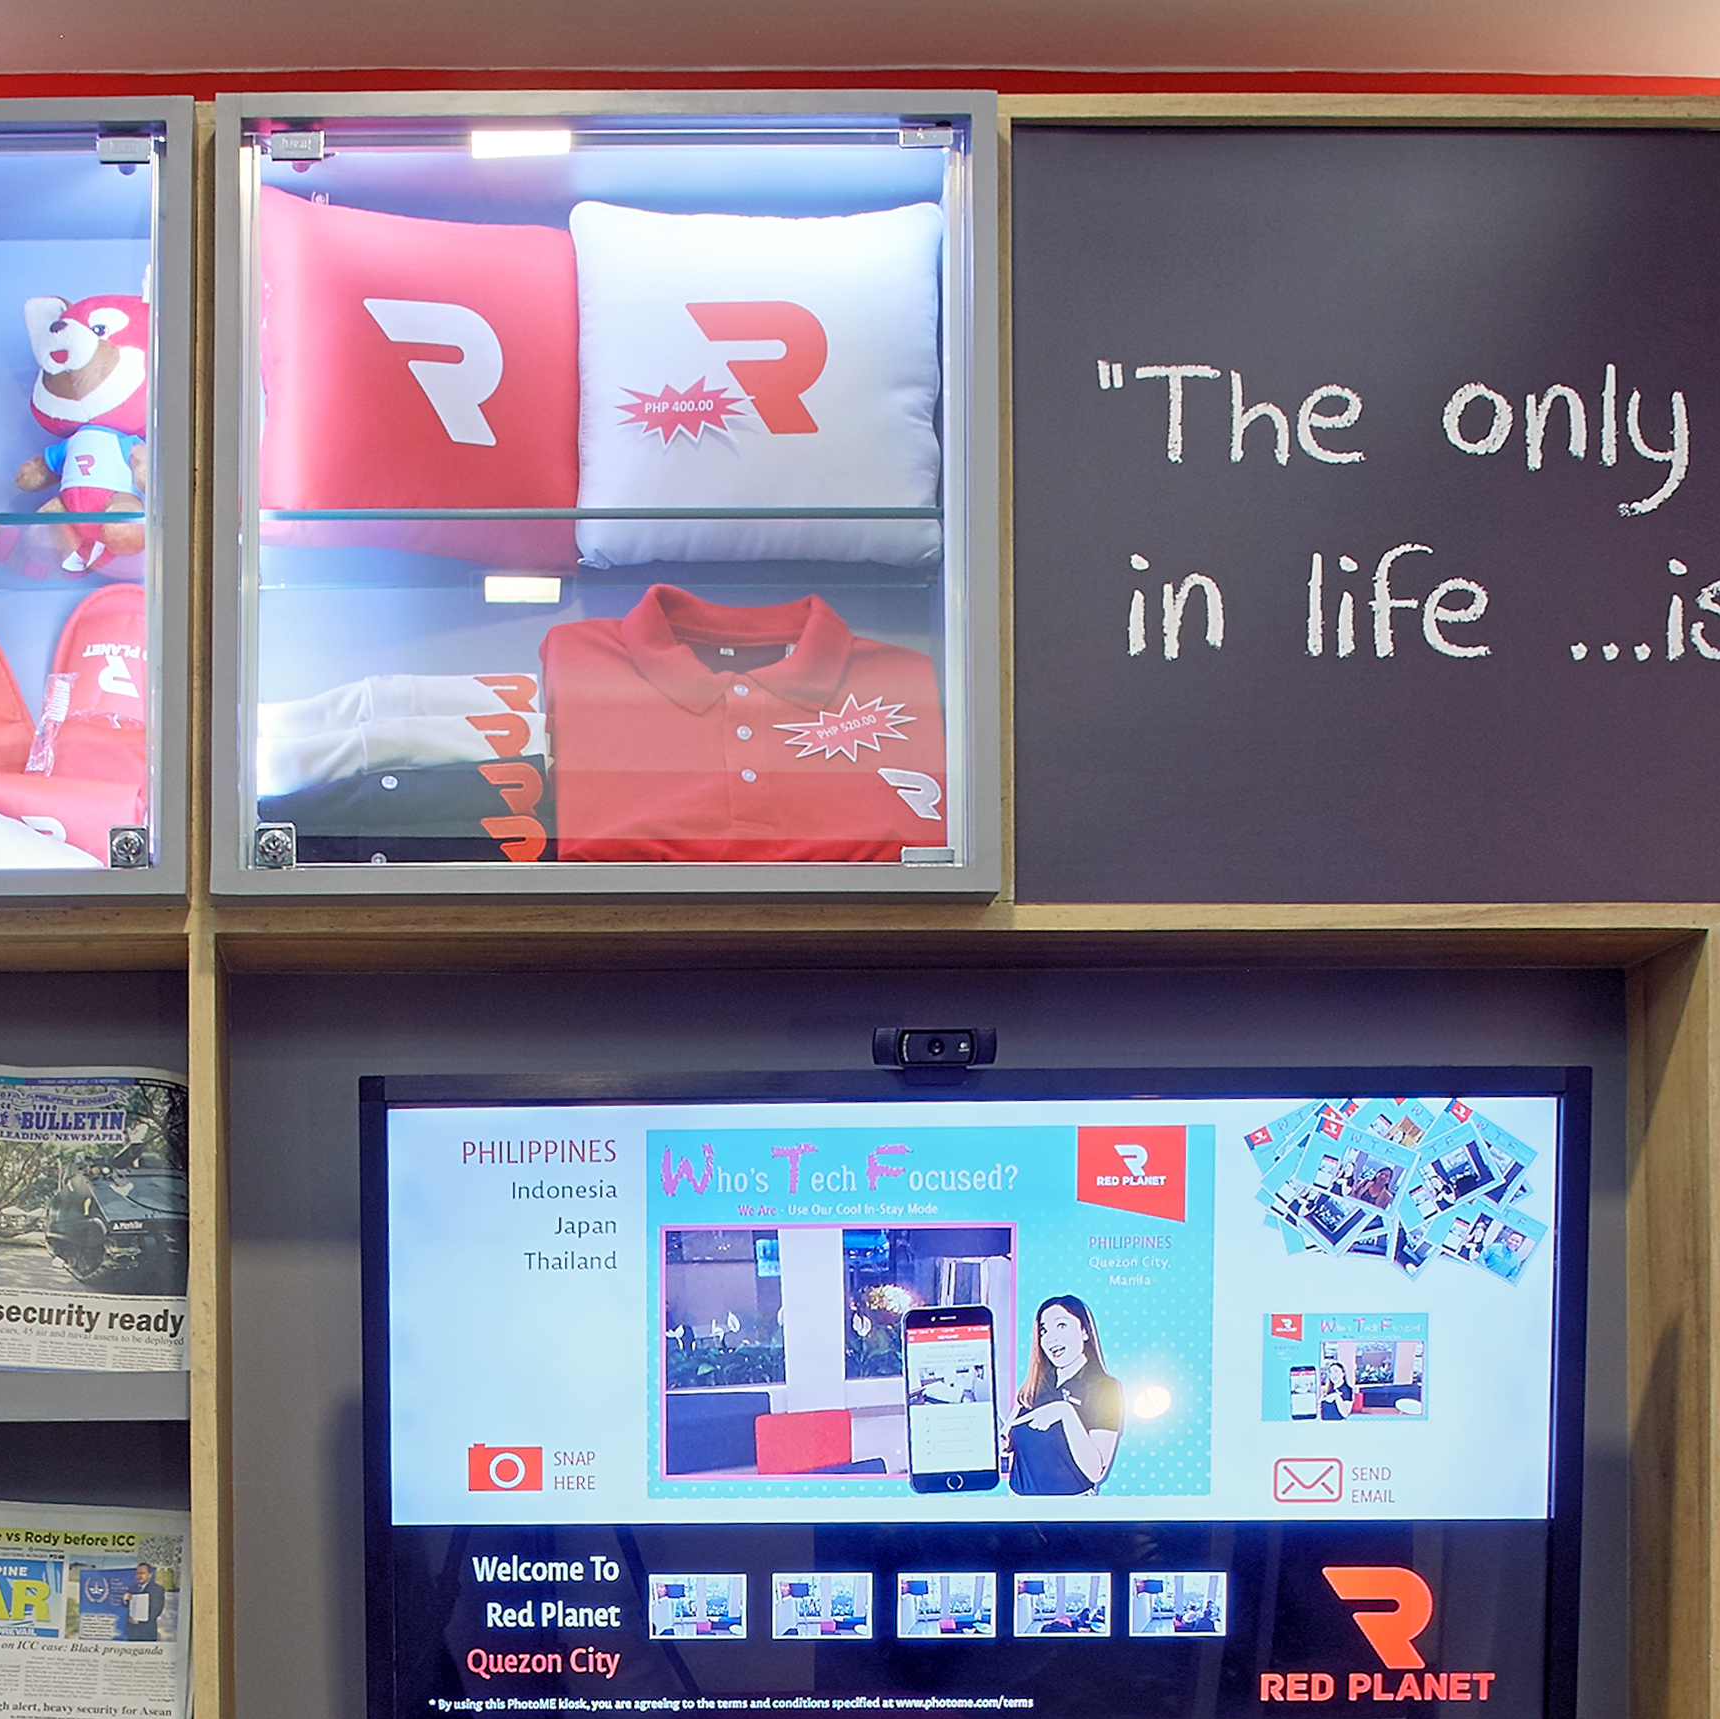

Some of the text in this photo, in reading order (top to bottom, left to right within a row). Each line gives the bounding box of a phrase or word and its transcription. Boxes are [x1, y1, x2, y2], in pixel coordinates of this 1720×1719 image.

[643, 398, 715, 415] PHP 400.00
[1096, 359, 1366, 467] "The
[1440, 363, 1689, 518] only
[1126, 553, 1225, 661] in
[1304, 543, 1492, 661] life
[815, 713, 878, 741] PHP 520.00
[21, 1110, 125, 1130] BULLETIN
[463, 1140, 617, 1164] PHILIPPINES
[772, 1143, 857, 1194] Tech
[867, 1144, 1019, 1191] Focused?
[511, 1180, 618, 1200] Indonesia
[1096, 1175, 1167, 1186] RED PLANET
[554, 1216, 618, 1238] Japan
[1089, 1236, 1173, 1250] PHILIPPINES
[524, 1252, 618, 1271] Thailand
[1089, 1256, 1137, 1270] Quezon
[1108, 1274, 1152, 1286] Manila
[108, 1308, 185, 1338] ready
[554, 1451, 596, 1466] SNAP
[554, 1476, 595, 1491] HERE
[1351, 1466, 1392, 1482] SEND
[1351, 1488, 1395, 1504] EMAIL
[5, 1533, 20, 1543] vs
[25, 1531, 60, 1548] Rody
[64, 1532, 108, 1547] before
[111, 1535, 136, 1547] ICC
[472, 1556, 621, 1582] Welcome To
[485, 1602, 621, 1628] Red Planet
[4, 1643, 13, 1651] on
[17, 1642, 39, 1652] ICC
[42, 1644, 67, 1653] case:
[70, 1644, 100, 1654] Black
[102, 1647, 164, 1658] propaganda
[467, 1648, 621, 1679] Quezon City
[1260, 1672, 1496, 1701] RED PLANET
[13, 1701, 40, 1714] alert,
[43, 1703, 73, 1716] heavy
[77, 1704, 119, 1717] security
[122, 1705, 138, 1715] for
[141, 1707, 172, 1717] Asean
[438, 1696, 1033, 1712] By using this PhotoME kiosk, you are agreeing to the terms and conditions specified at www.photome.com/terms
